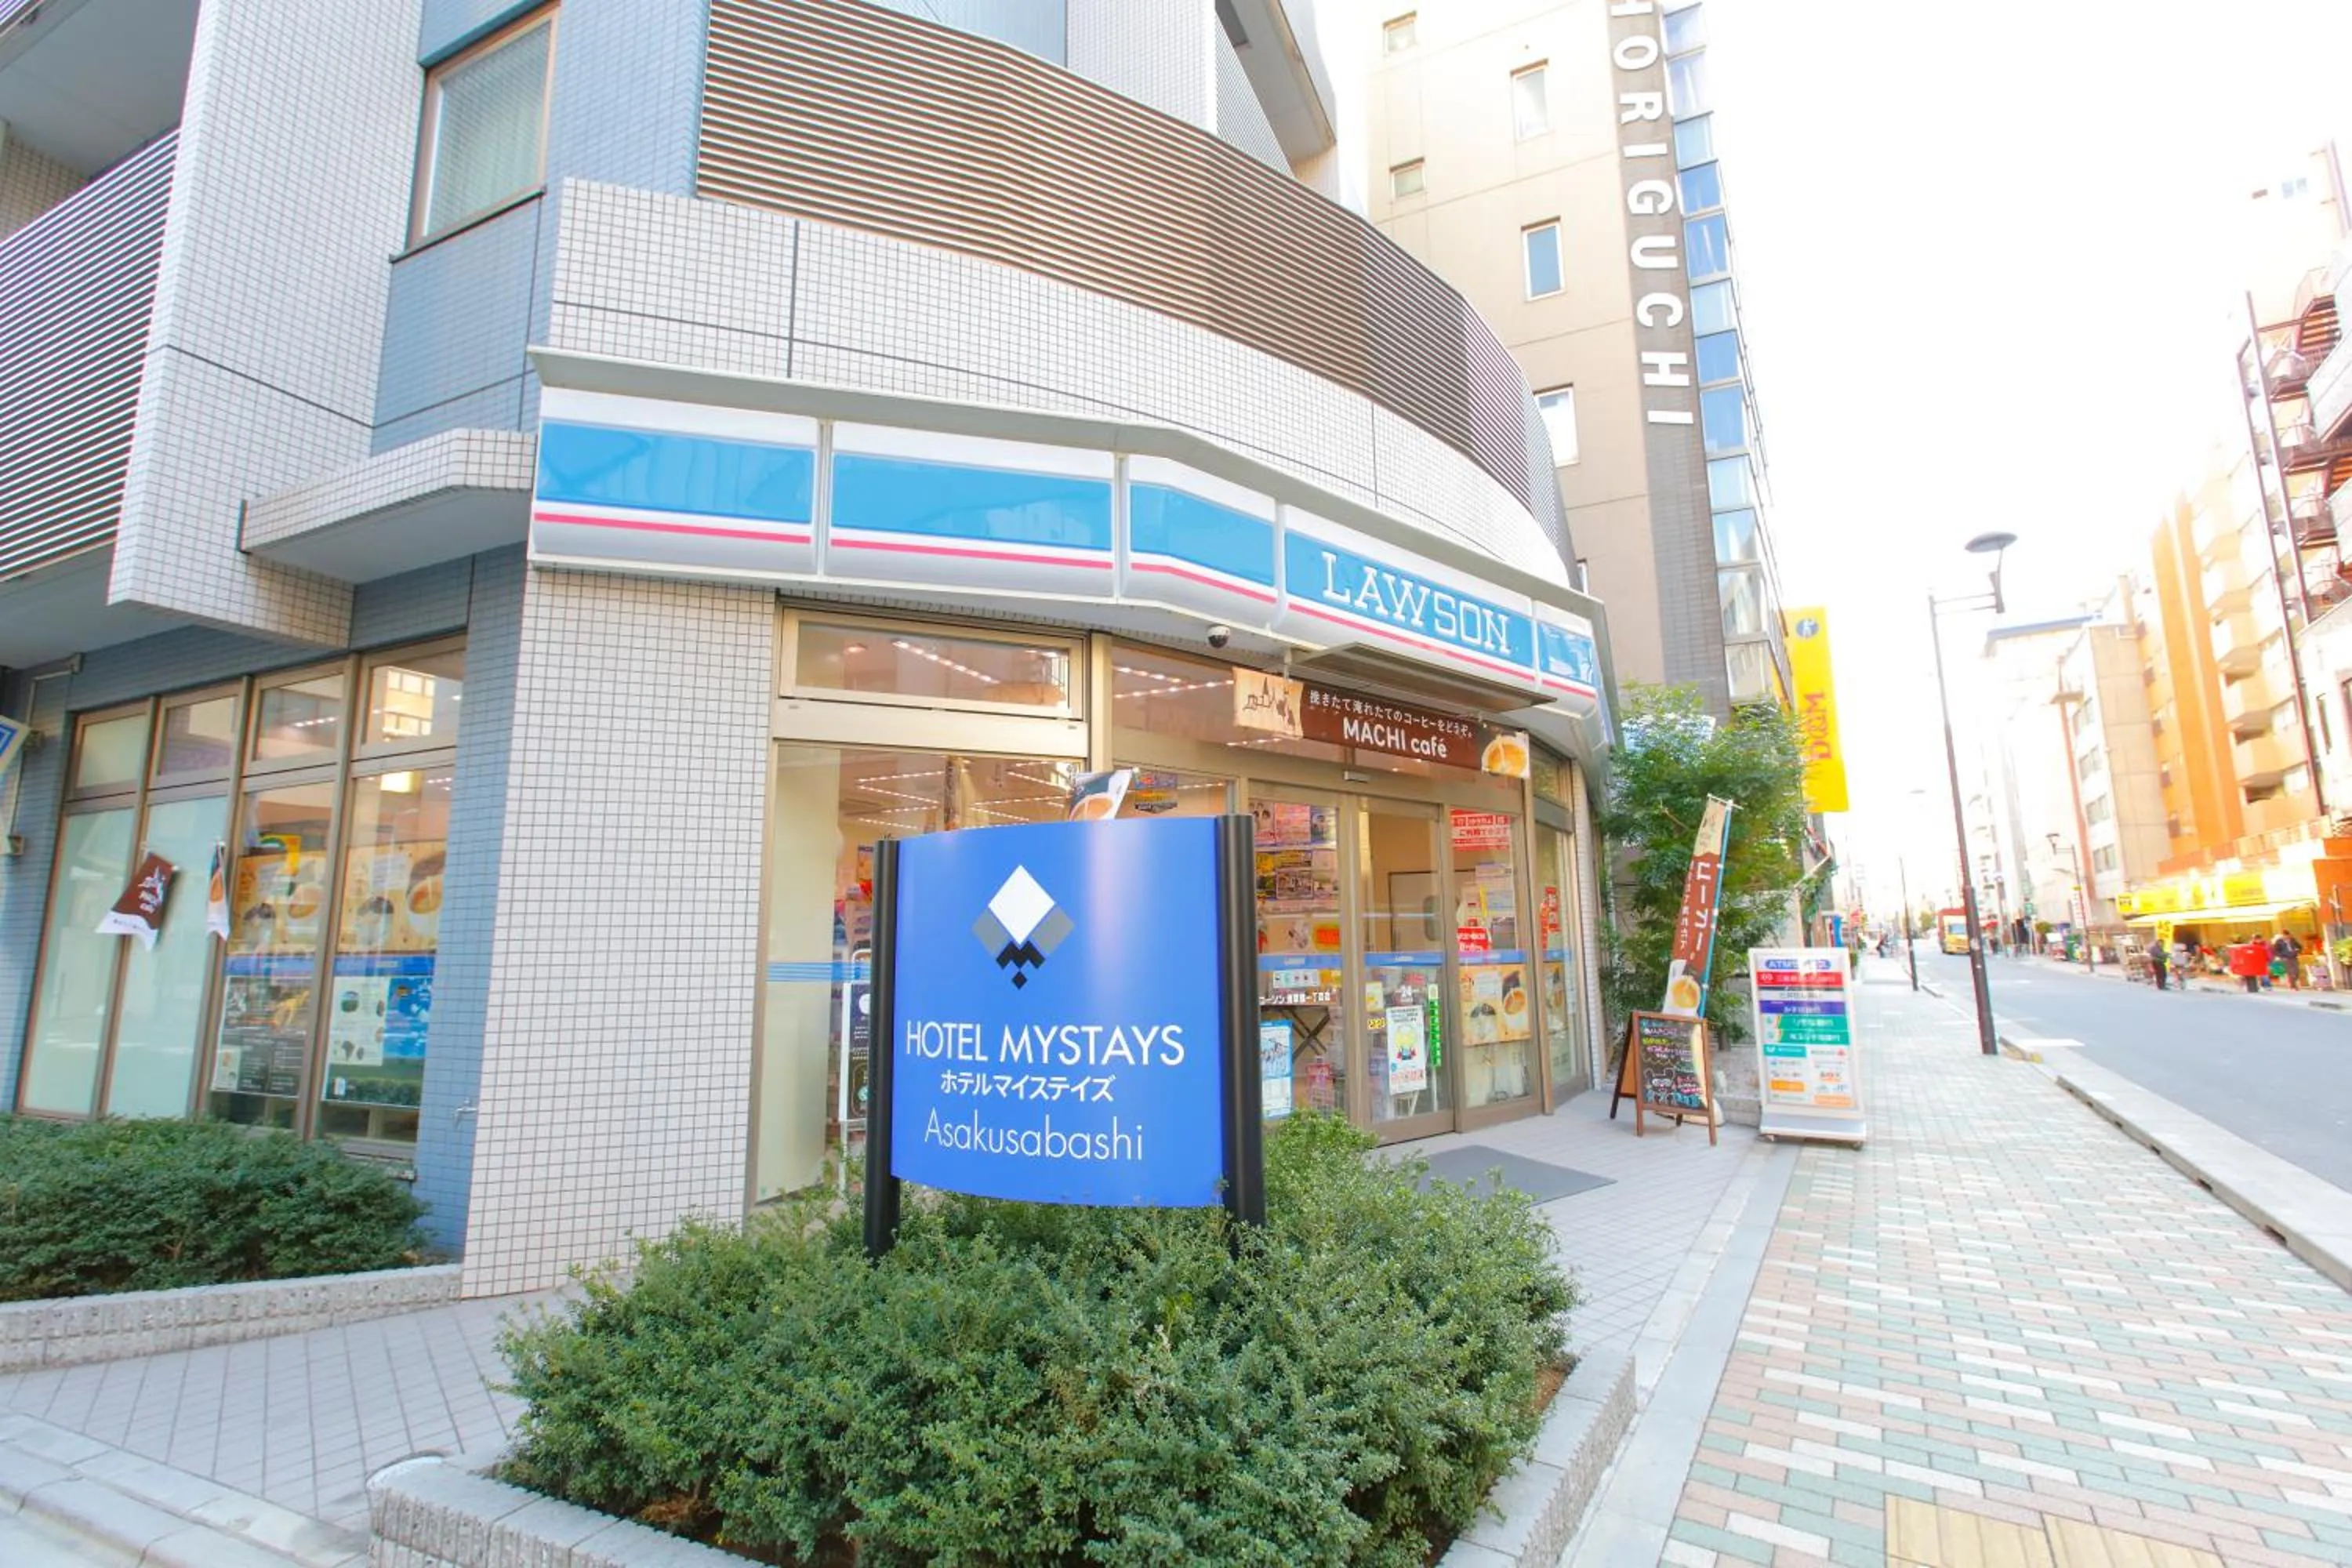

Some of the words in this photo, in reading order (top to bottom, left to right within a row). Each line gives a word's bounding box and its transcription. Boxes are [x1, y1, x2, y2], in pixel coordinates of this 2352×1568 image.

[1321, 551, 1512, 655] LAWSON
[1343, 717, 1406, 751] MACHI
[1410, 735, 1449, 758] café
[906, 1020, 989, 1062] HOTEL
[1000, 1024, 1185, 1066] MYSTAYS
[940, 1069, 1117, 1102] ホテルマイステイズ
[924, 1105, 1144, 1161] Asakusabashi
